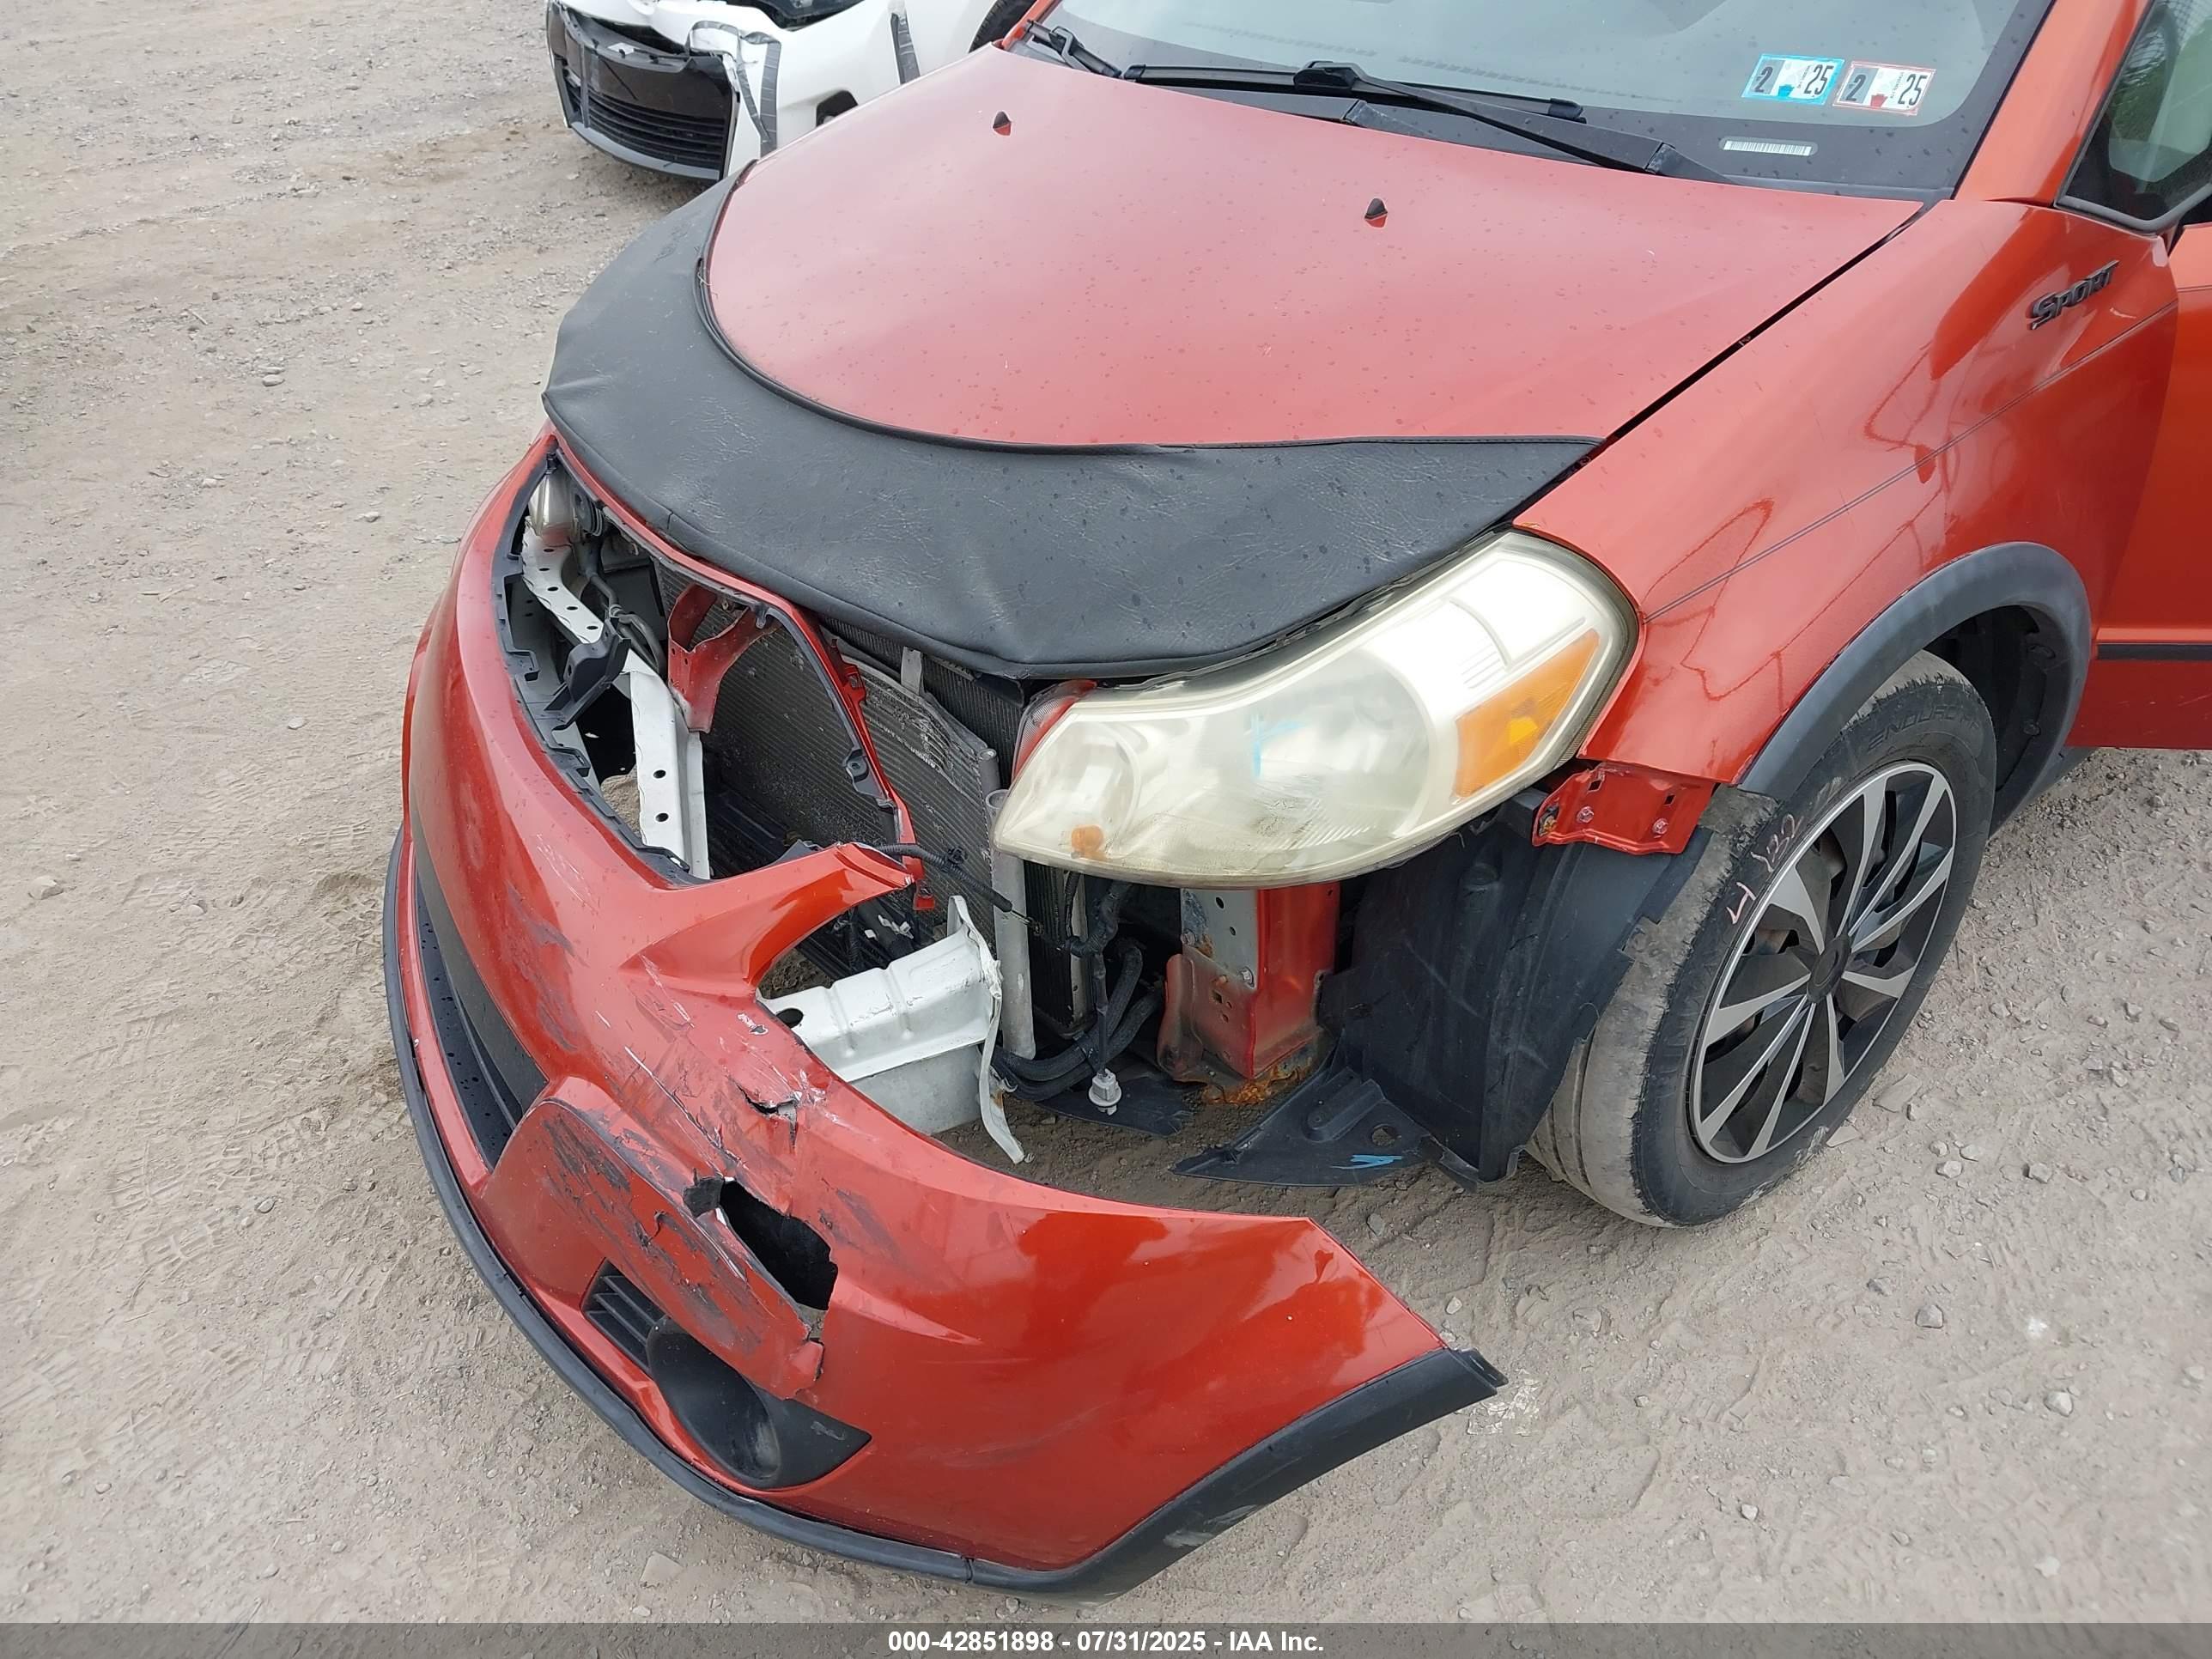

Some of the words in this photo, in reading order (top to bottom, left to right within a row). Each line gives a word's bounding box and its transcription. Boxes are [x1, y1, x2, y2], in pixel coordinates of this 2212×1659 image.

[1754, 66, 1773, 93] 2
[1804, 64, 1834, 94] 25
[1845, 74, 1866, 101] 2
[1898, 74, 1928, 106] 25
